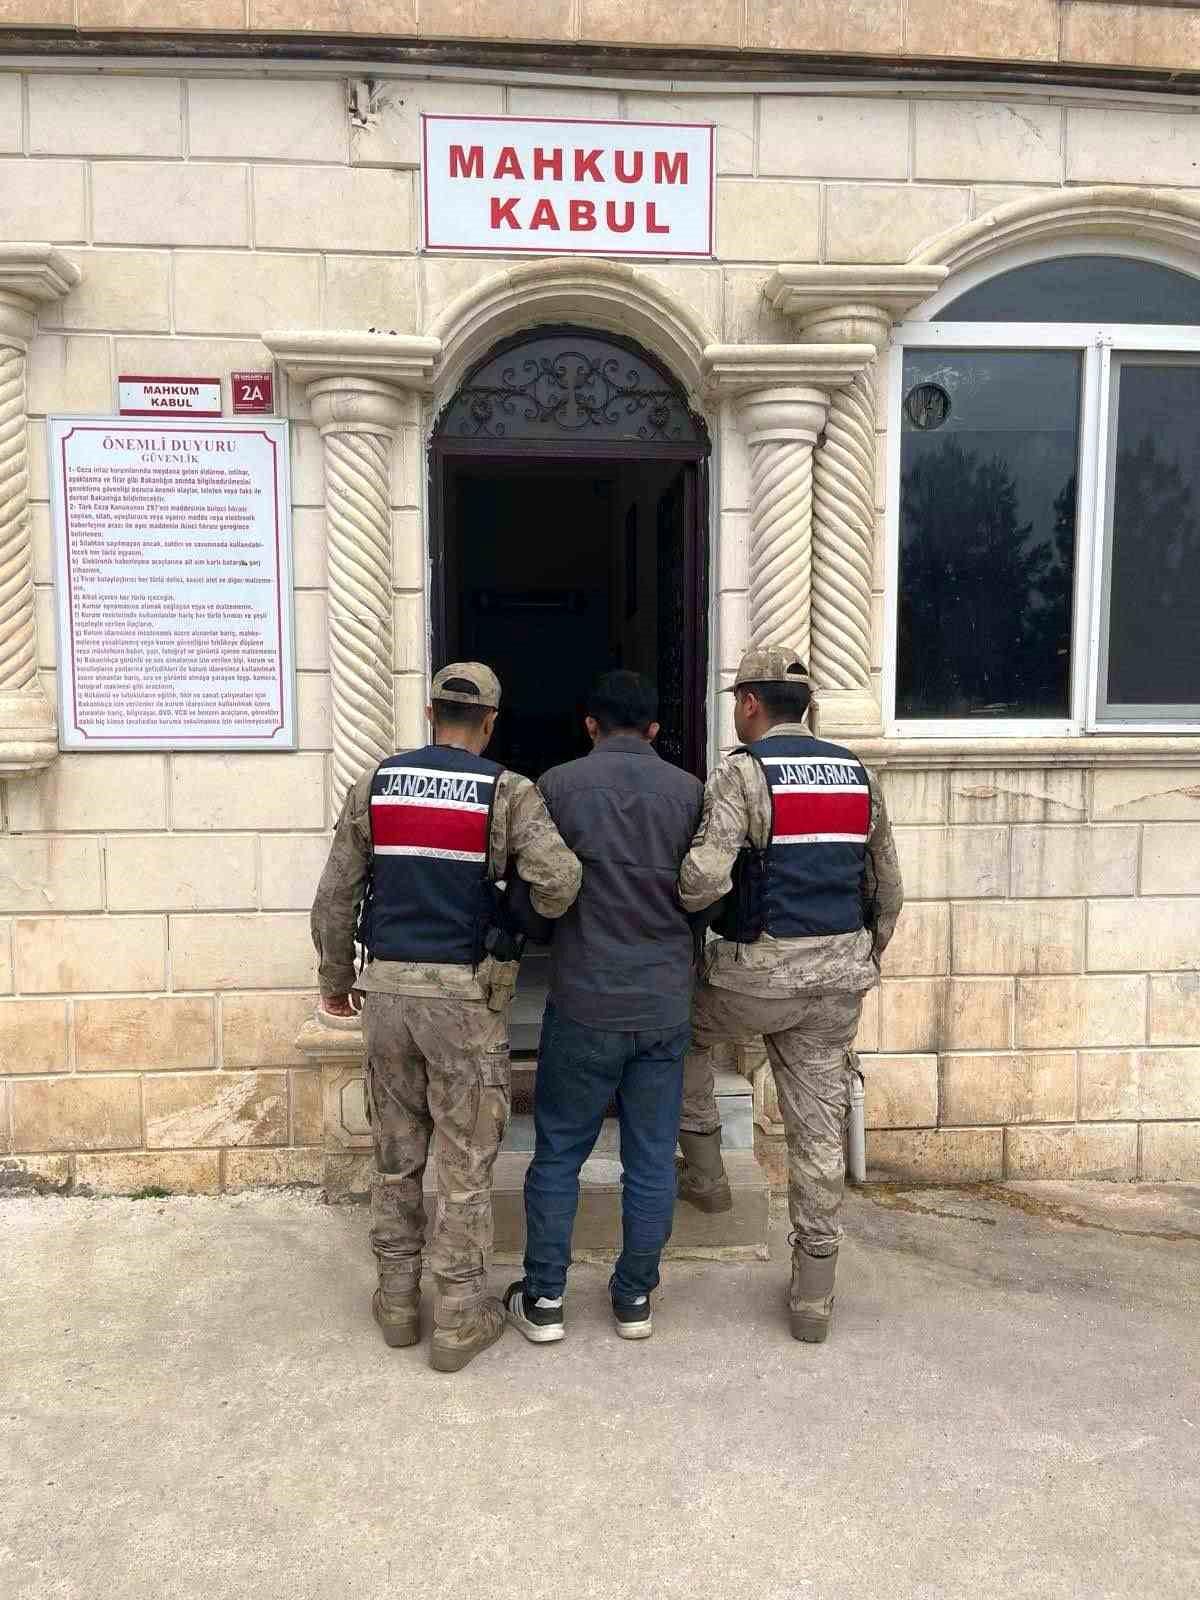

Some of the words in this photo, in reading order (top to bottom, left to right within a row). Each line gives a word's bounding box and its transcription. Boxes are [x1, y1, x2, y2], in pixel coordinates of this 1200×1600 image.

[448, 144, 689, 185] MAHKUM
[489, 197, 671, 234] KABUL
[143, 385, 200, 396] MAHKUM
[241, 385, 264, 401] 2A
[151, 397, 193, 408] KABUL
[102, 436, 170, 451] ÖNEMLİ
[171, 439, 237, 452] DUYURU
[141, 453, 199, 464] GÜVENLİK
[778, 764, 860, 785] JANDARMA
[382, 774, 479, 803] JANDARMA
